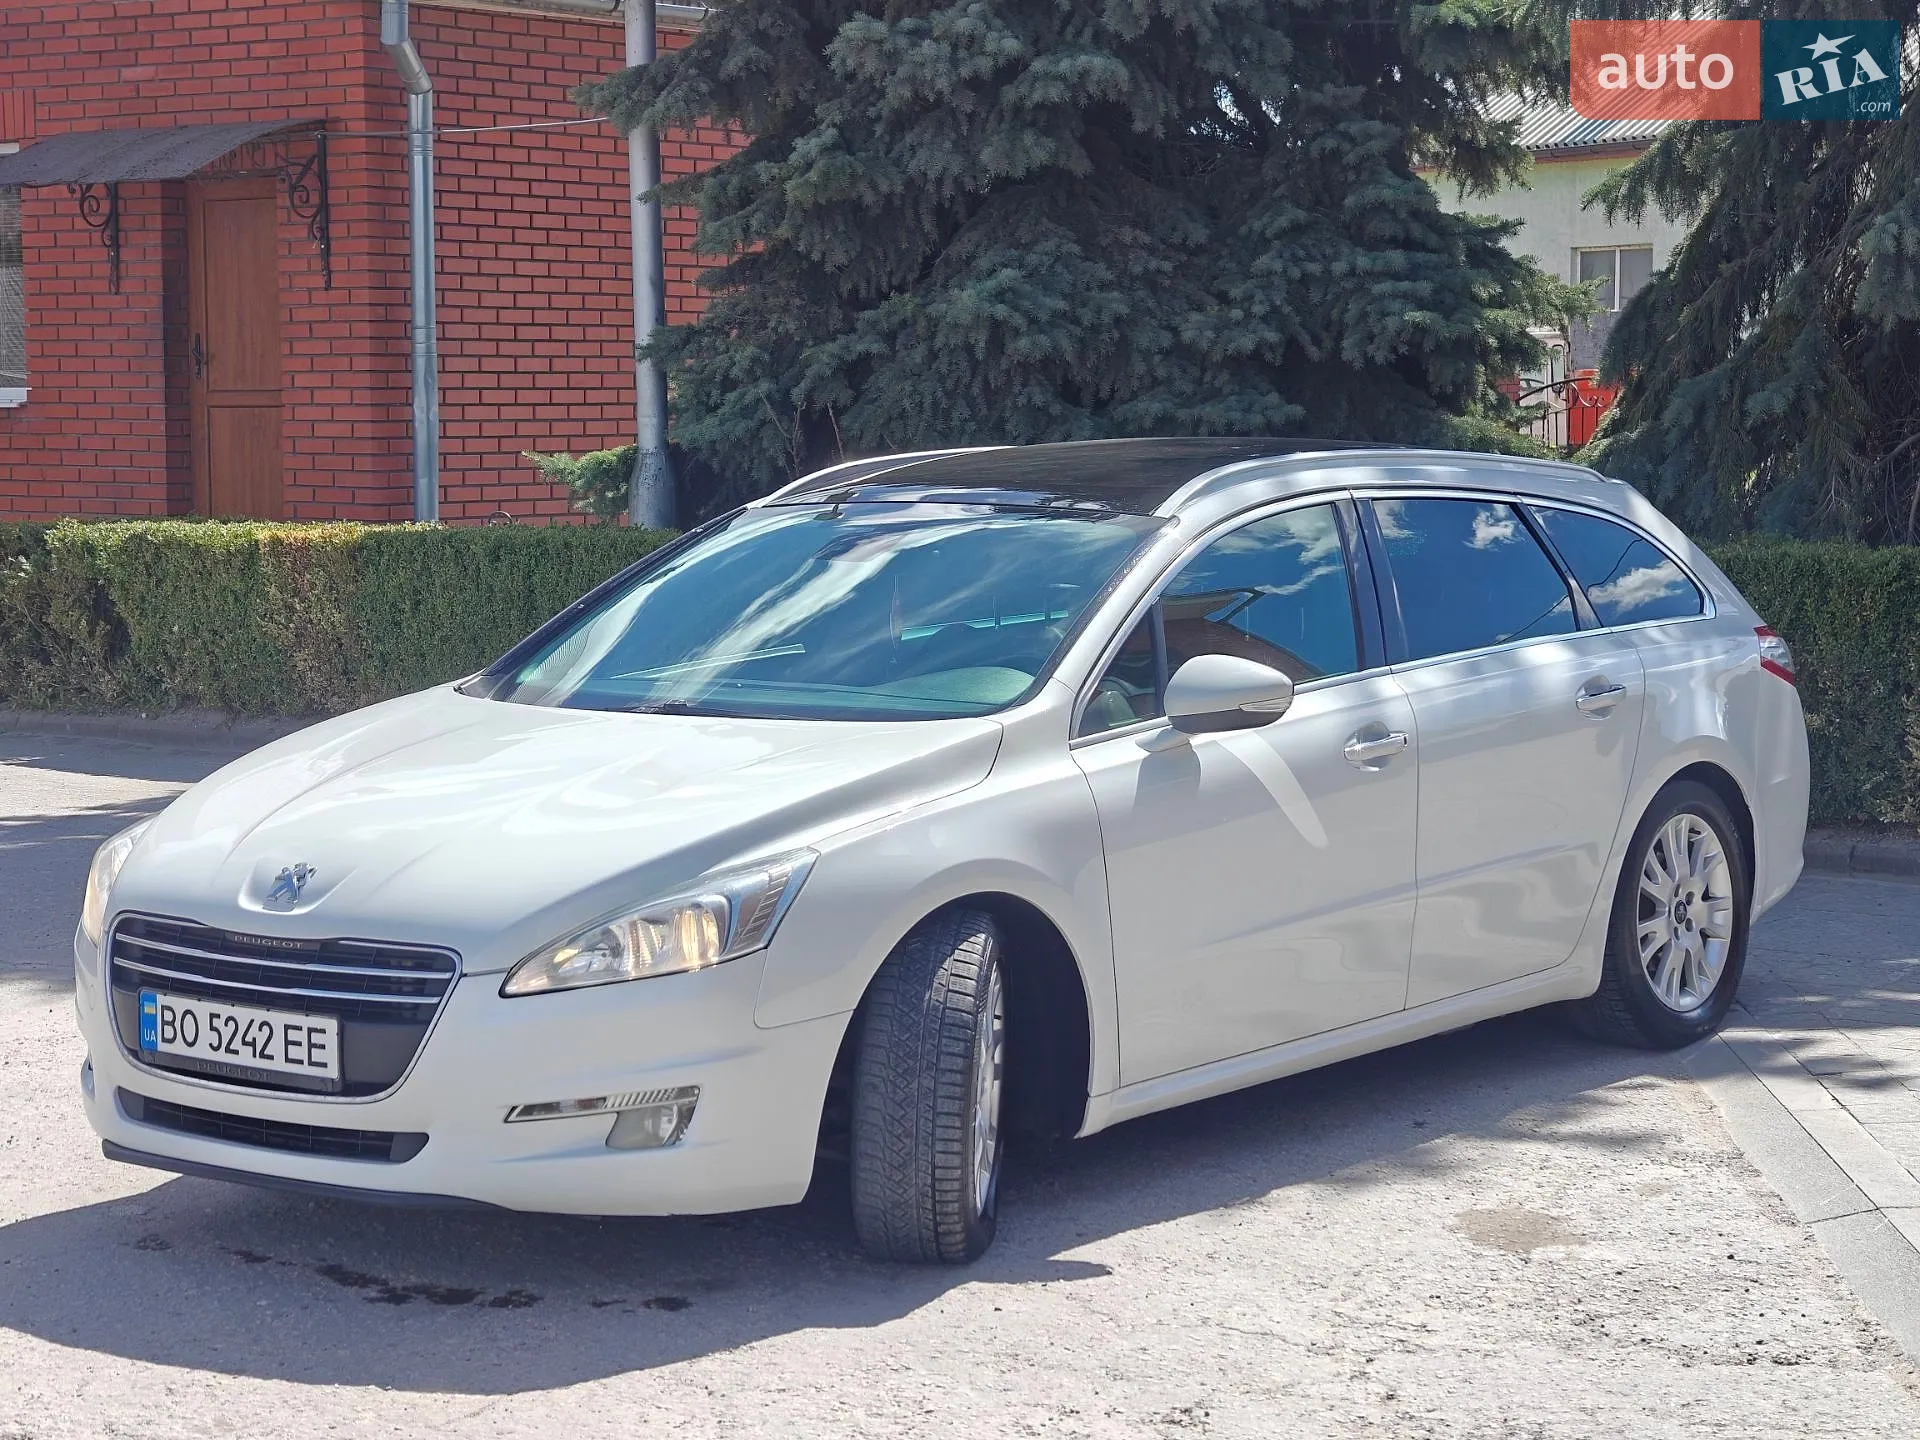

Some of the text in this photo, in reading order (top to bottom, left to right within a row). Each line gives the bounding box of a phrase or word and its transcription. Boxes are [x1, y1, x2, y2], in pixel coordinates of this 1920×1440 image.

[234, 935, 304, 949] PEUGEOT
[144, 1028, 157, 1043] UA
[160, 1004, 328, 1069] BO 5242 EE
